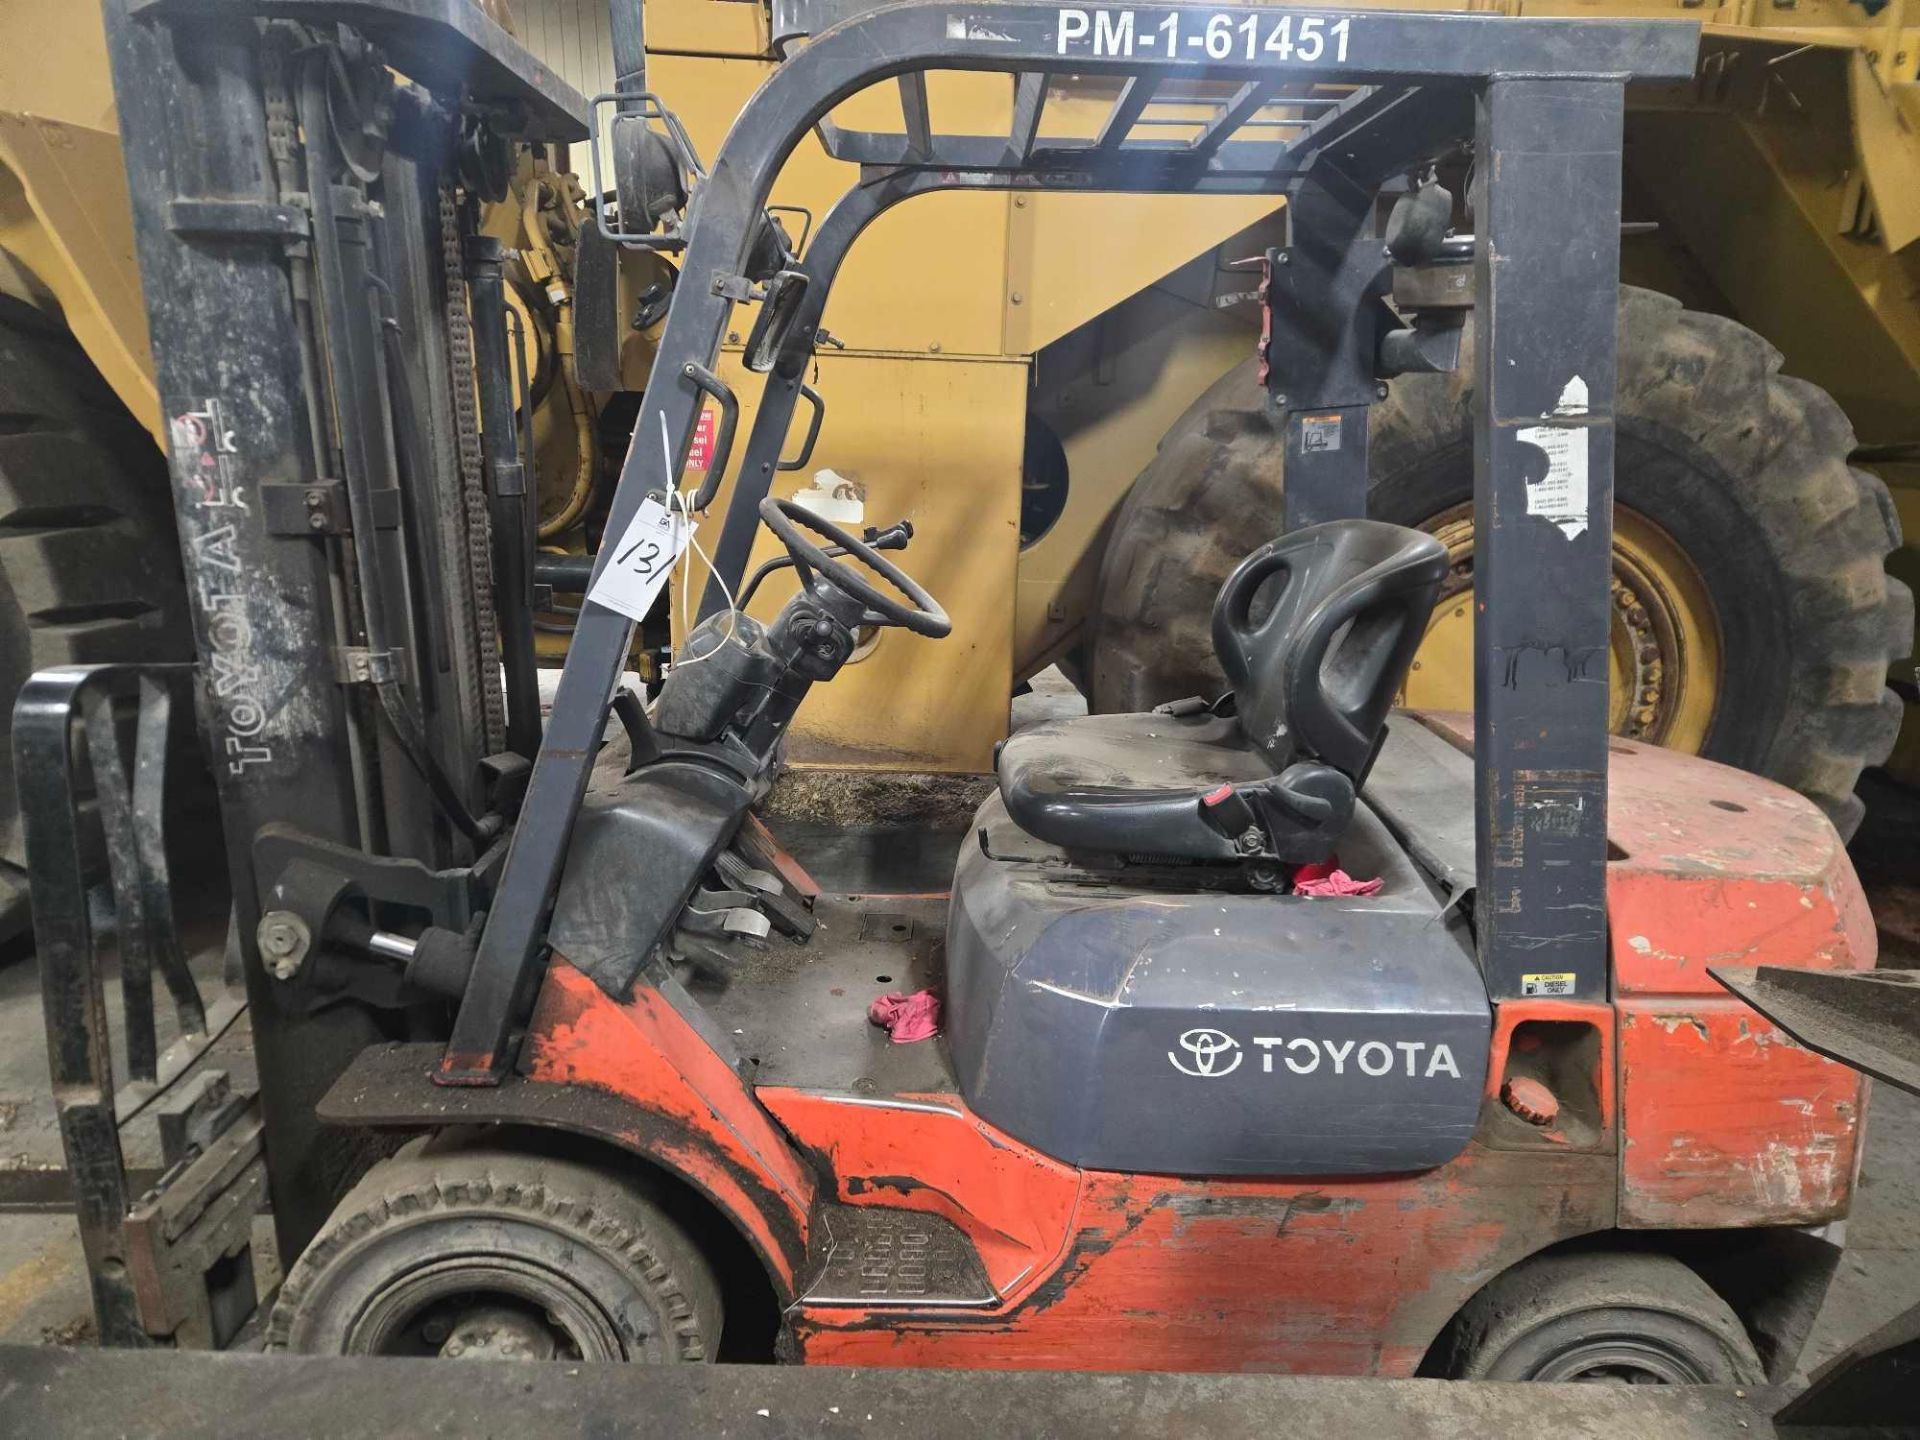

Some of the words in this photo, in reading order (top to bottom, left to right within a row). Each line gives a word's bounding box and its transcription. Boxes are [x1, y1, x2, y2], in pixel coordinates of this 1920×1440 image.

[1056, 9, 1351, 62] PM-1-61451
[617, 538, 677, 585] 131
[193, 523, 272, 775] TOYOTA
[1253, 1037, 1462, 1079] TOYOTA
